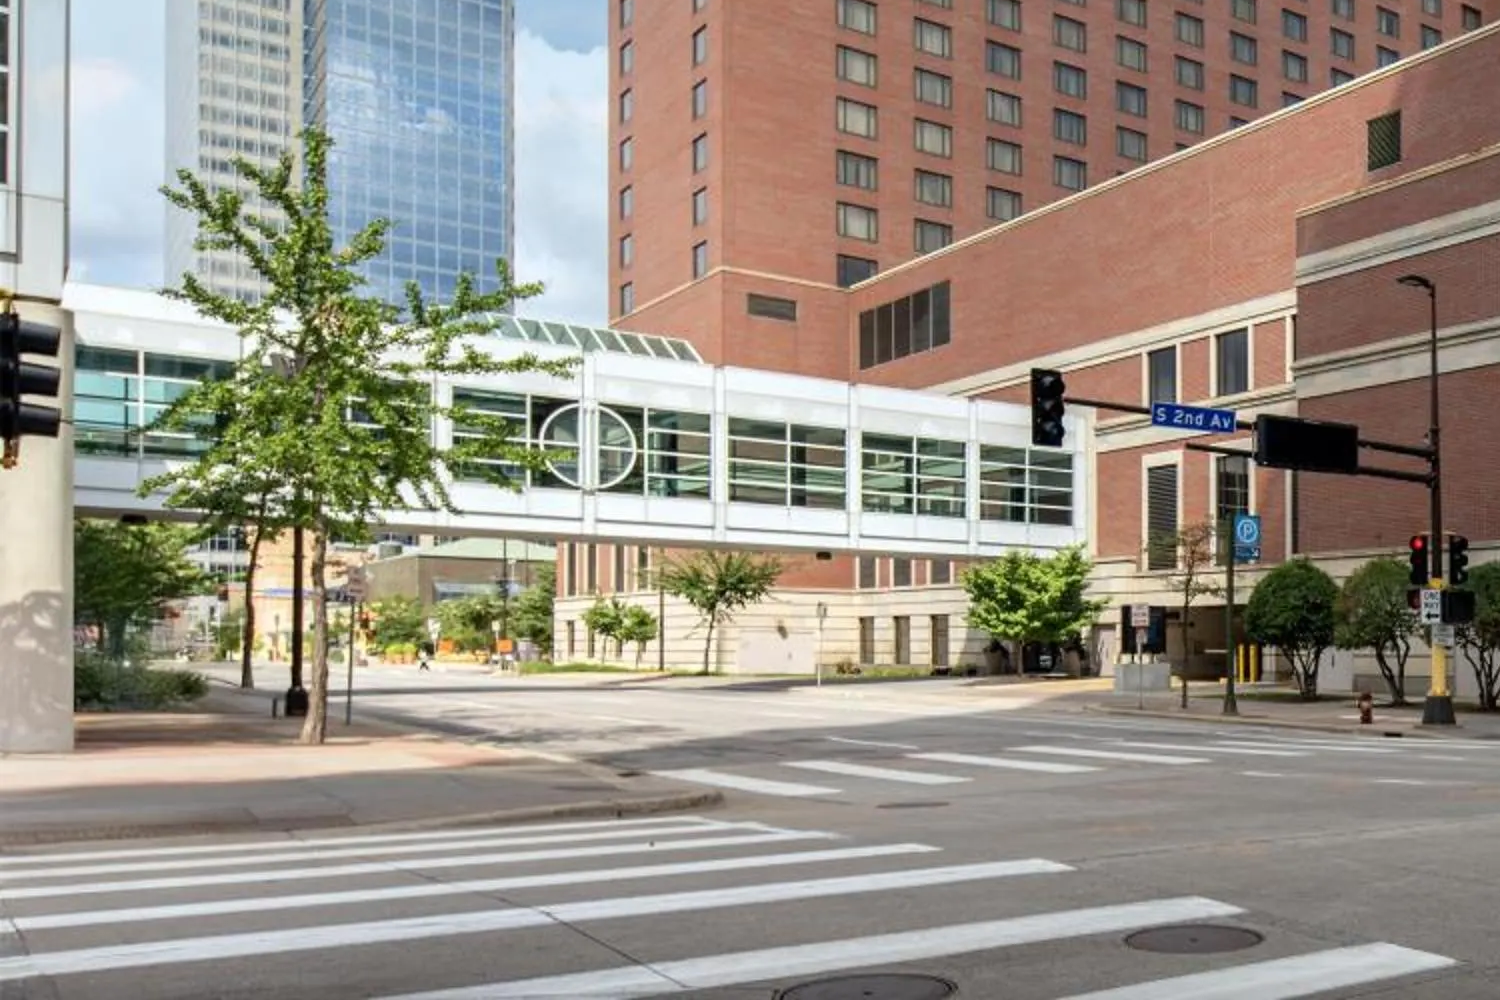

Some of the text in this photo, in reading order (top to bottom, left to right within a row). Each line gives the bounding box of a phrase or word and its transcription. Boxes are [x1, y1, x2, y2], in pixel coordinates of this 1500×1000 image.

[1156, 407, 1231, 429] S 2nd Av
